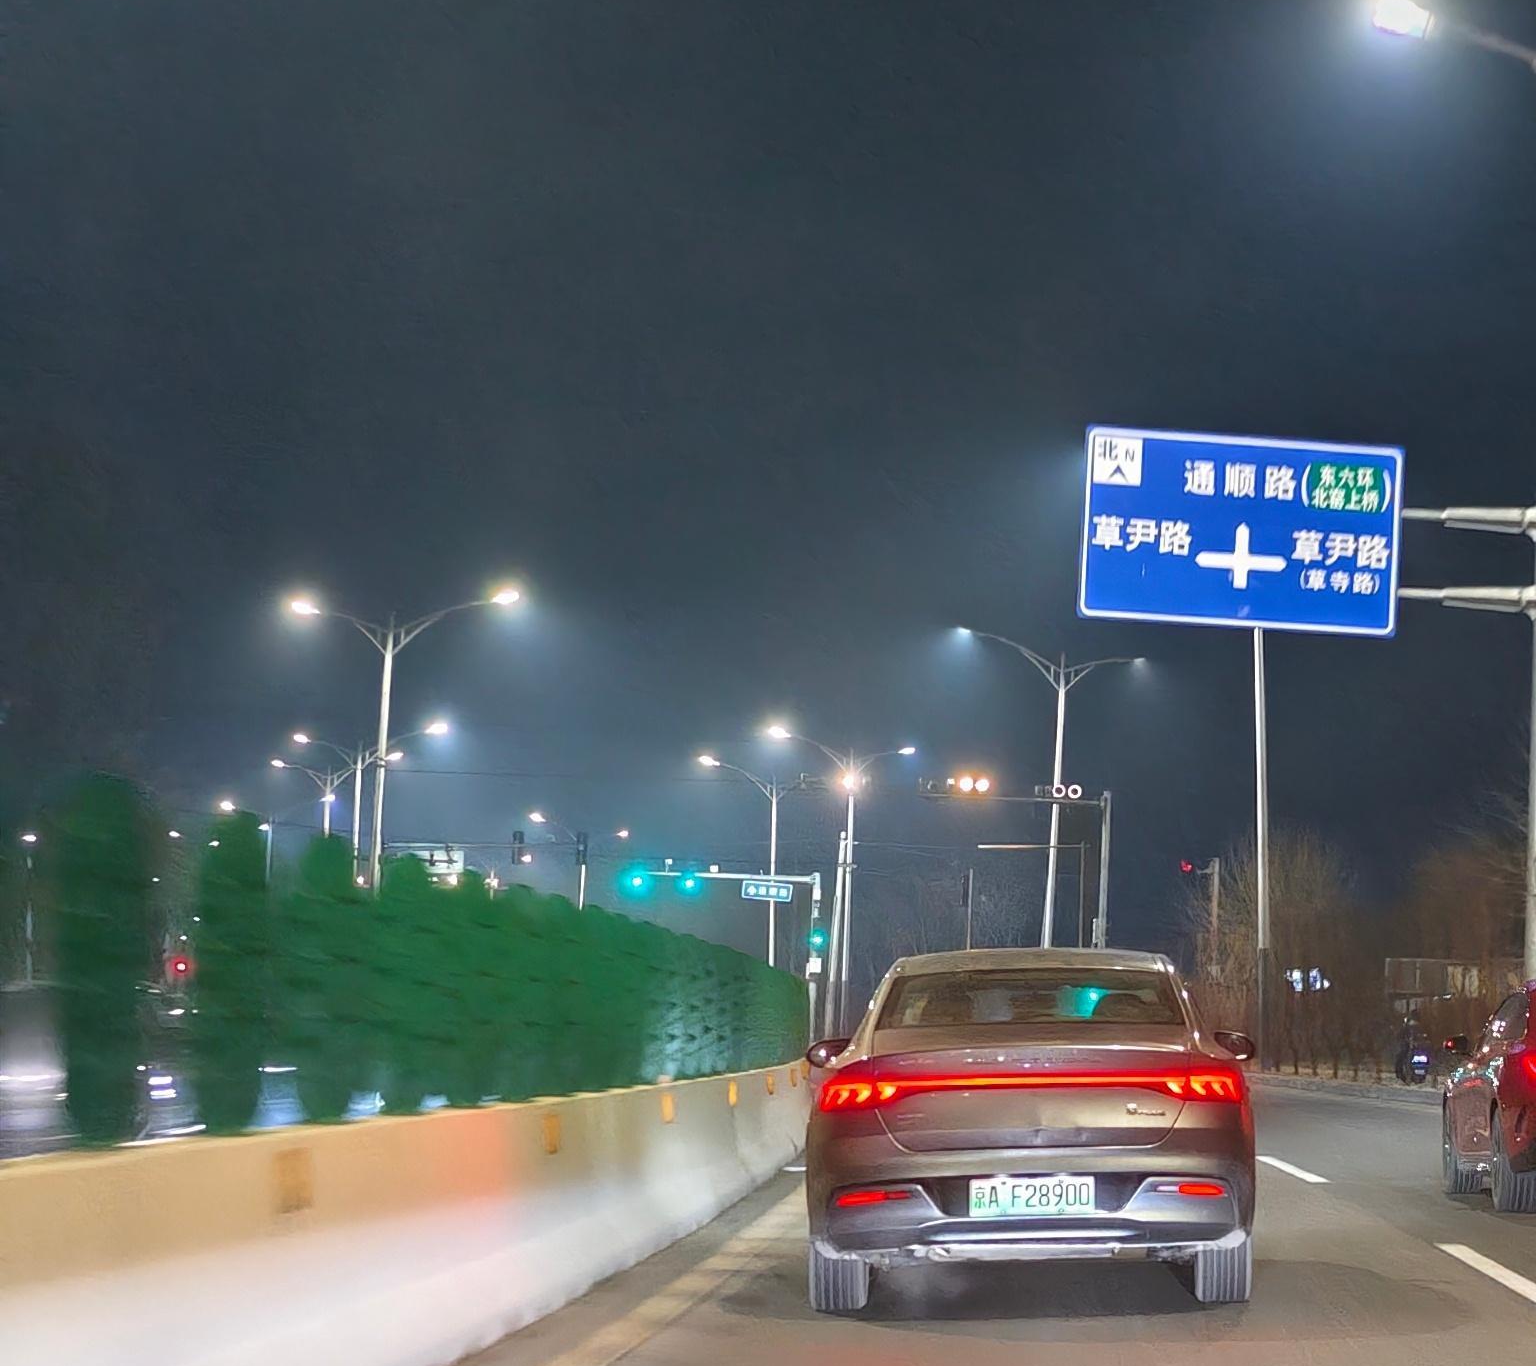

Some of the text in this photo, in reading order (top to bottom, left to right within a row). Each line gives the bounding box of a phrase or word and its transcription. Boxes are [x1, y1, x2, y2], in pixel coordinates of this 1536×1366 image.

[1098, 439, 1135, 463] 北 N
[1183, 459, 1298, 501] 通顺路
[1091, 514, 1193, 556] 草尹路
[1291, 529, 1391, 569] 草尹路
